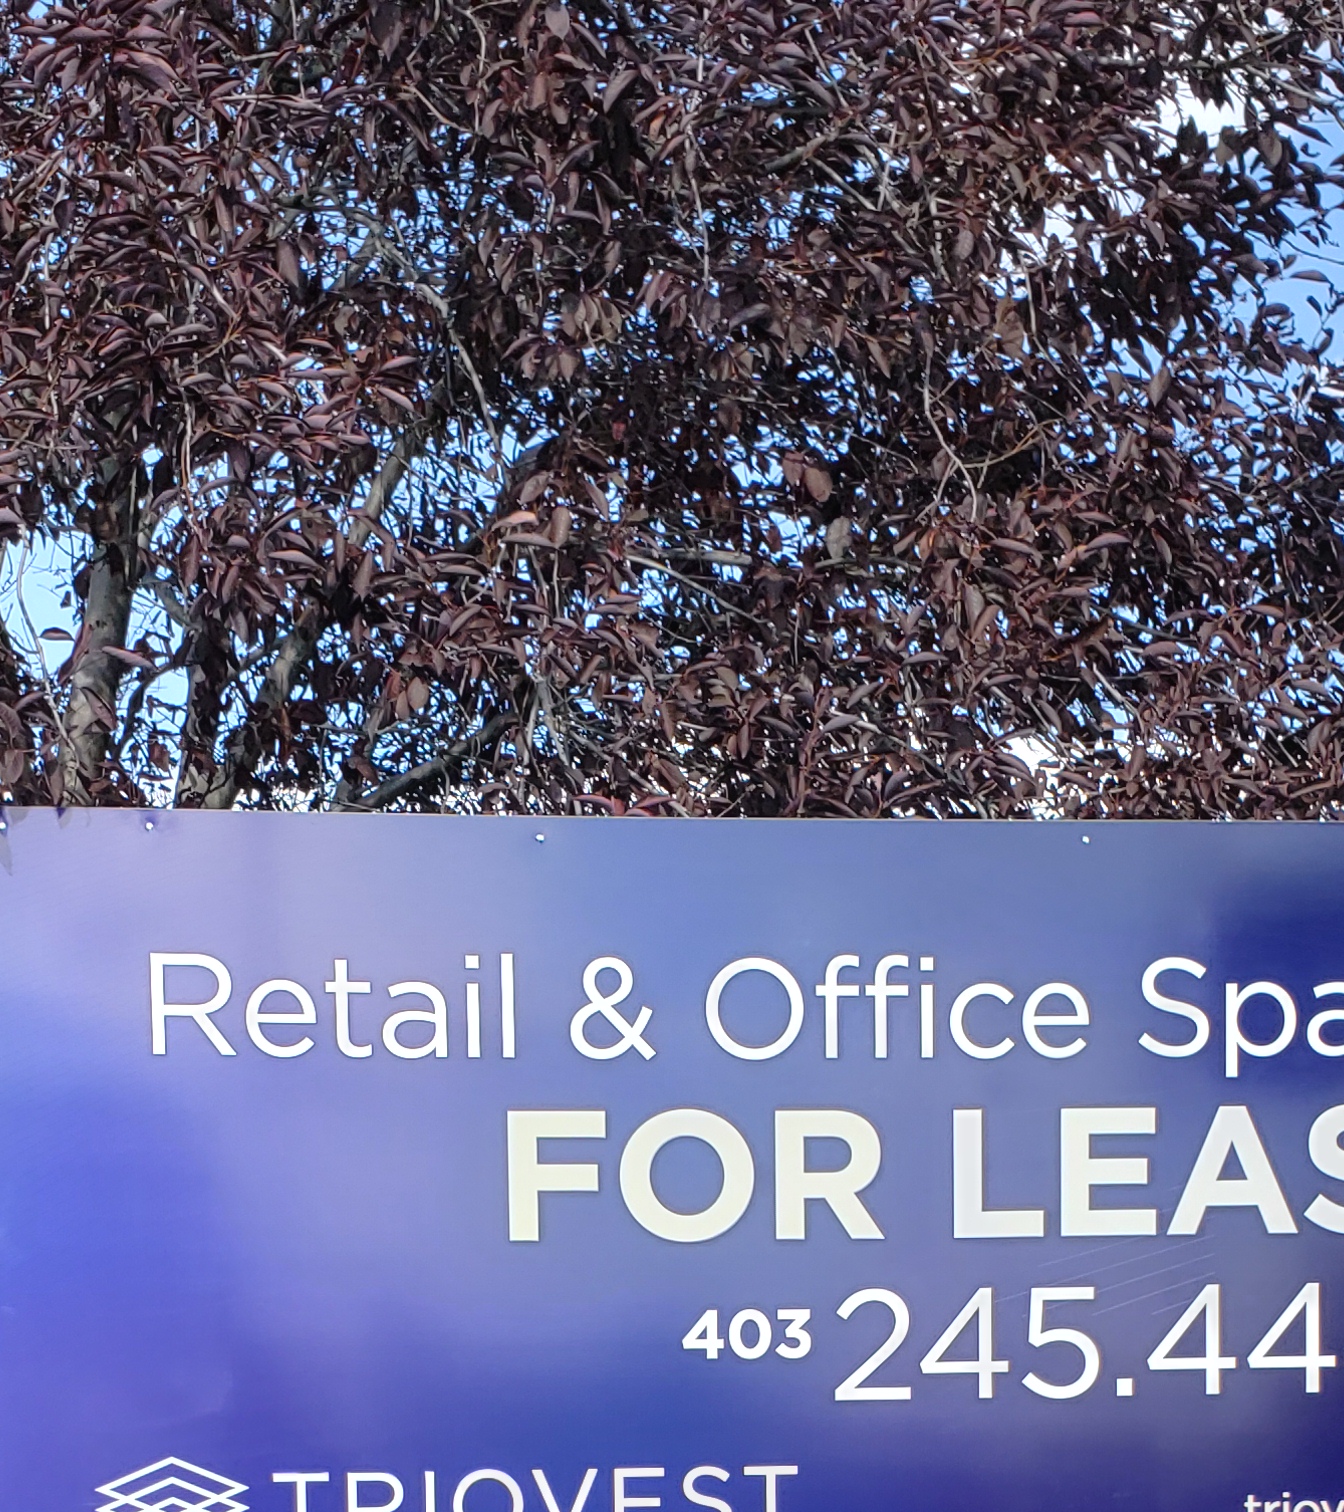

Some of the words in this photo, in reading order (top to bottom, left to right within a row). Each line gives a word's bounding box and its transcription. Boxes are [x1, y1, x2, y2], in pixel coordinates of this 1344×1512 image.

[148, 952, 516, 1060] Retail
[570, 955, 658, 1062] &
[704, 953, 1092, 1061] Office
[505, 1107, 886, 1244] FOR
[680, 1307, 813, 1361] 403
